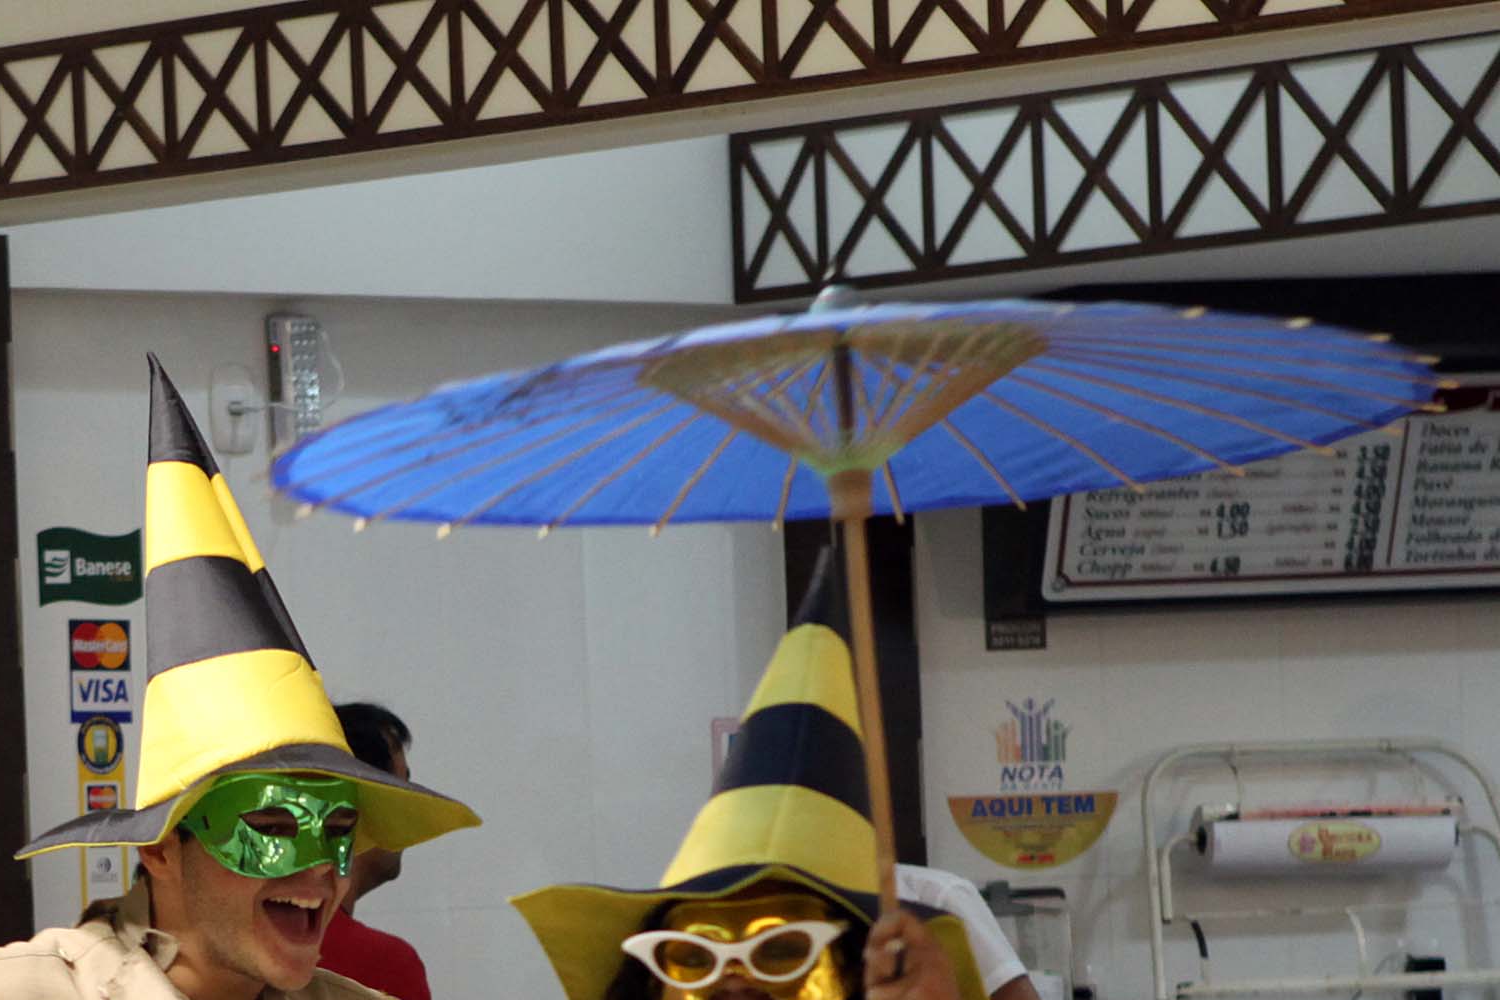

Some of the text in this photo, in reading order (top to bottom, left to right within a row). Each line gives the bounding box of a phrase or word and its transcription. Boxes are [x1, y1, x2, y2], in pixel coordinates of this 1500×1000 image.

[74, 557, 133, 576] Banese
[78, 679, 129, 703] VISA
[1000, 765, 1065, 782] NOTA
[971, 795, 1096, 817] AQUI TEM
